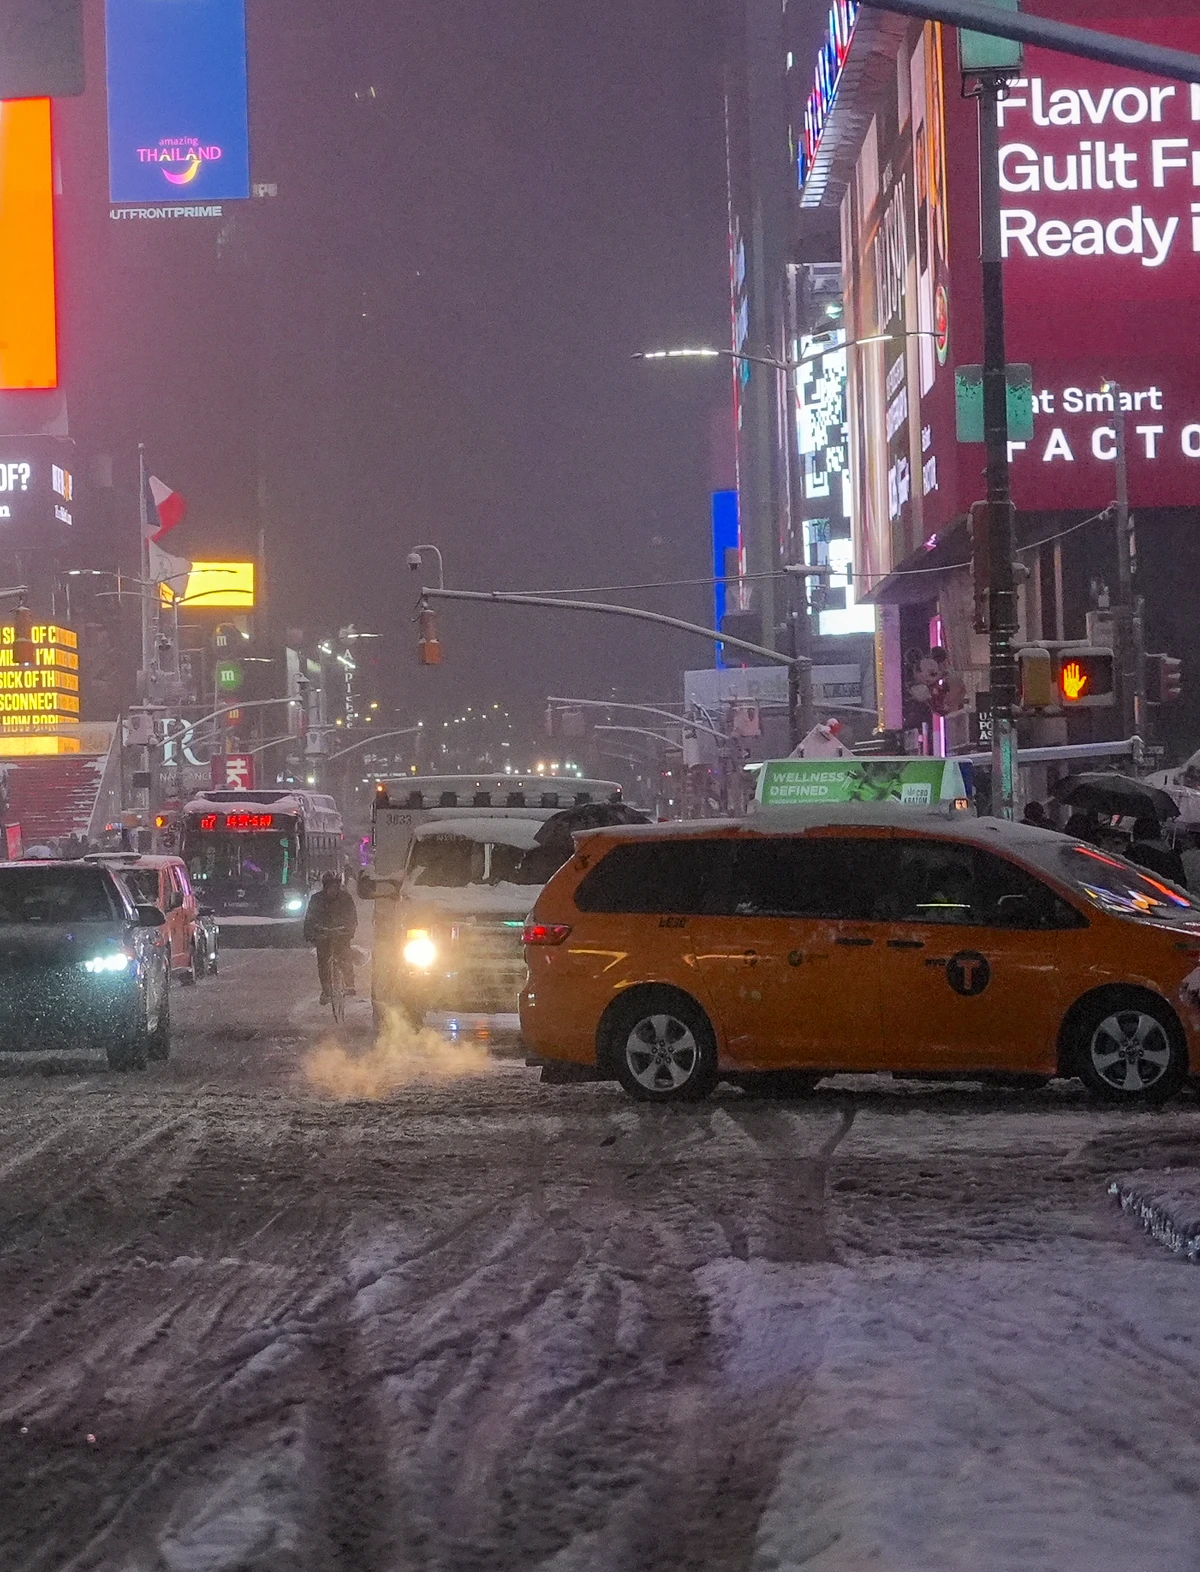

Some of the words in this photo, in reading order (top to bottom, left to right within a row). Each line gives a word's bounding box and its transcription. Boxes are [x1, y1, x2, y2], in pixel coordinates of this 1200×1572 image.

[996, 78, 1176, 127] Flavor
[159, 136, 199, 147] amazing
[136, 146, 221, 162] THAILAND
[998, 140, 1138, 193] Guilt
[110, 206, 222, 220] UTFRONTPRIME
[1000, 205, 1179, 267] Ready
[1063, 386, 1163, 413] Smart
[31, 626, 46, 644] OF
[36, 648, 55, 666] I'M
[24, 670, 40, 688] OF
[221, 669, 235, 681] m
[773, 771, 845, 783] WELLNESS
[769, 785, 829, 796] DEFINED
